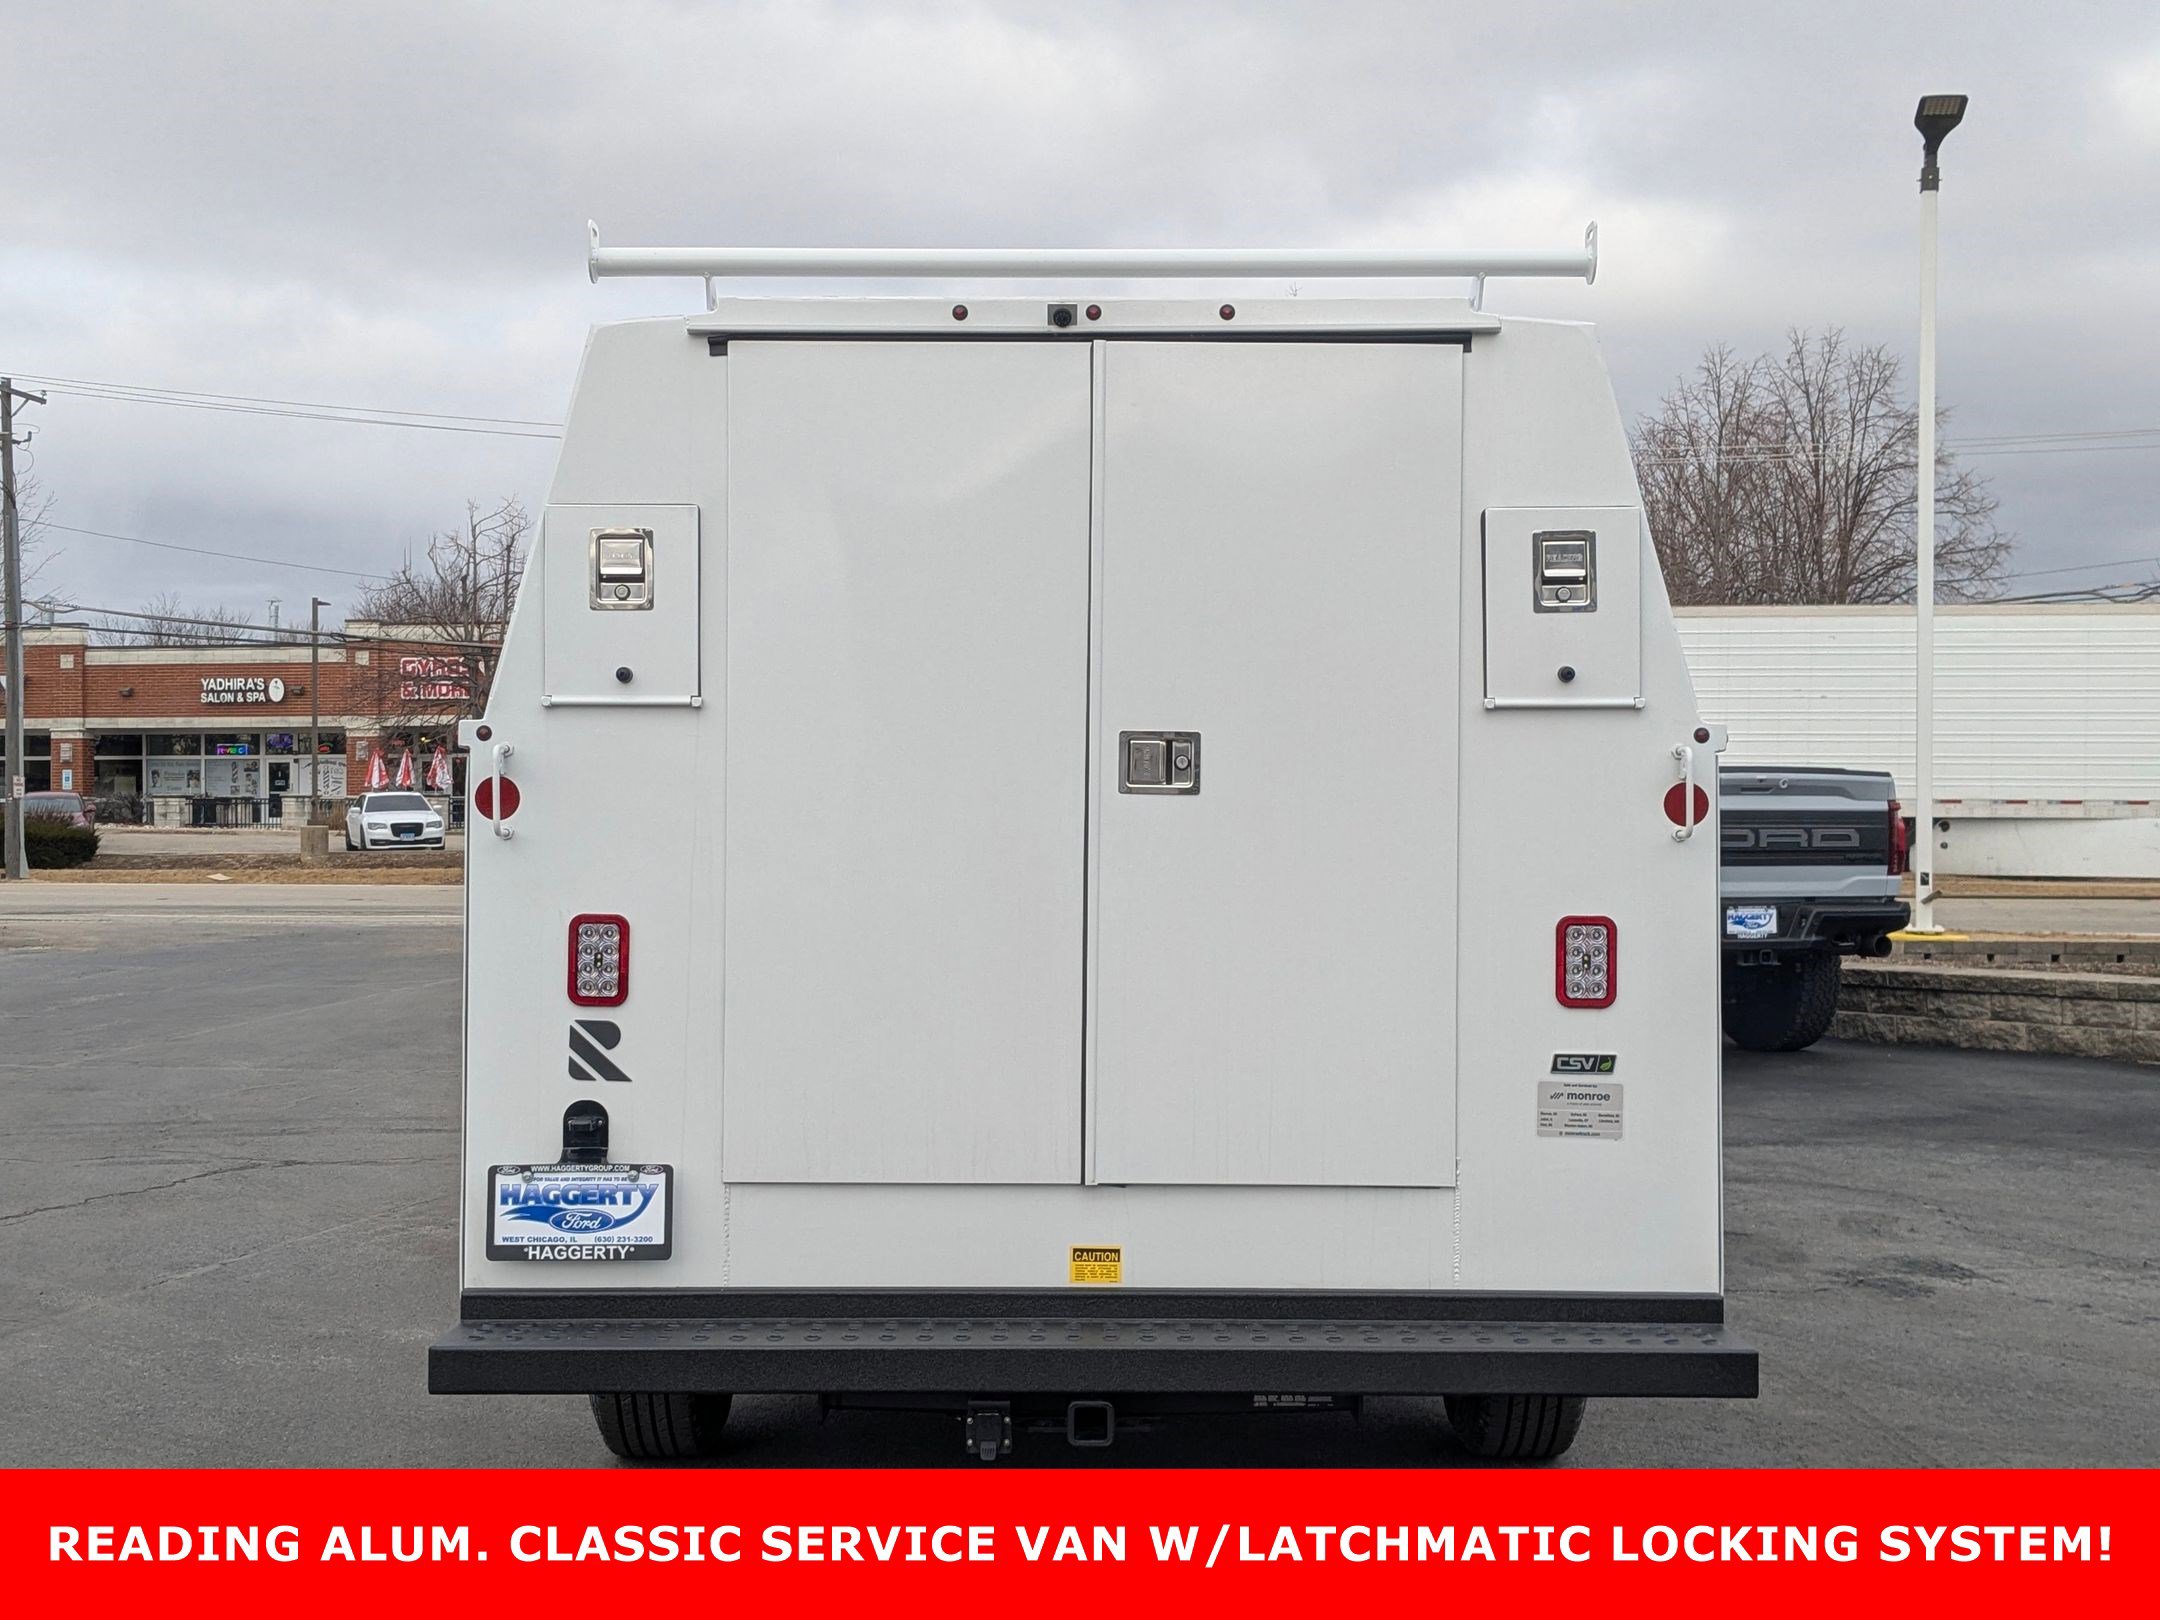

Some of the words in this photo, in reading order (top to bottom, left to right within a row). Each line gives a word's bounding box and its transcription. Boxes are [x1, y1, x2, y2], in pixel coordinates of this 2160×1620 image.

[201, 677, 265, 691] YADHIRA'S
[200, 692, 234, 703] SALON
[237, 692, 244, 703] &
[246, 692, 266, 703] SPA
[1720, 828, 1860, 847] ORD
[1557, 1057, 1595, 1070] CSV
[1566, 1092, 1611, 1101] monroe
[500, 1184, 659, 1206] HAGGERTY
[562, 1210, 601, 1229] Ford
[527, 1236, 568, 1244] CHICAGO,
[1074, 1252, 1119, 1262] CAUTION
